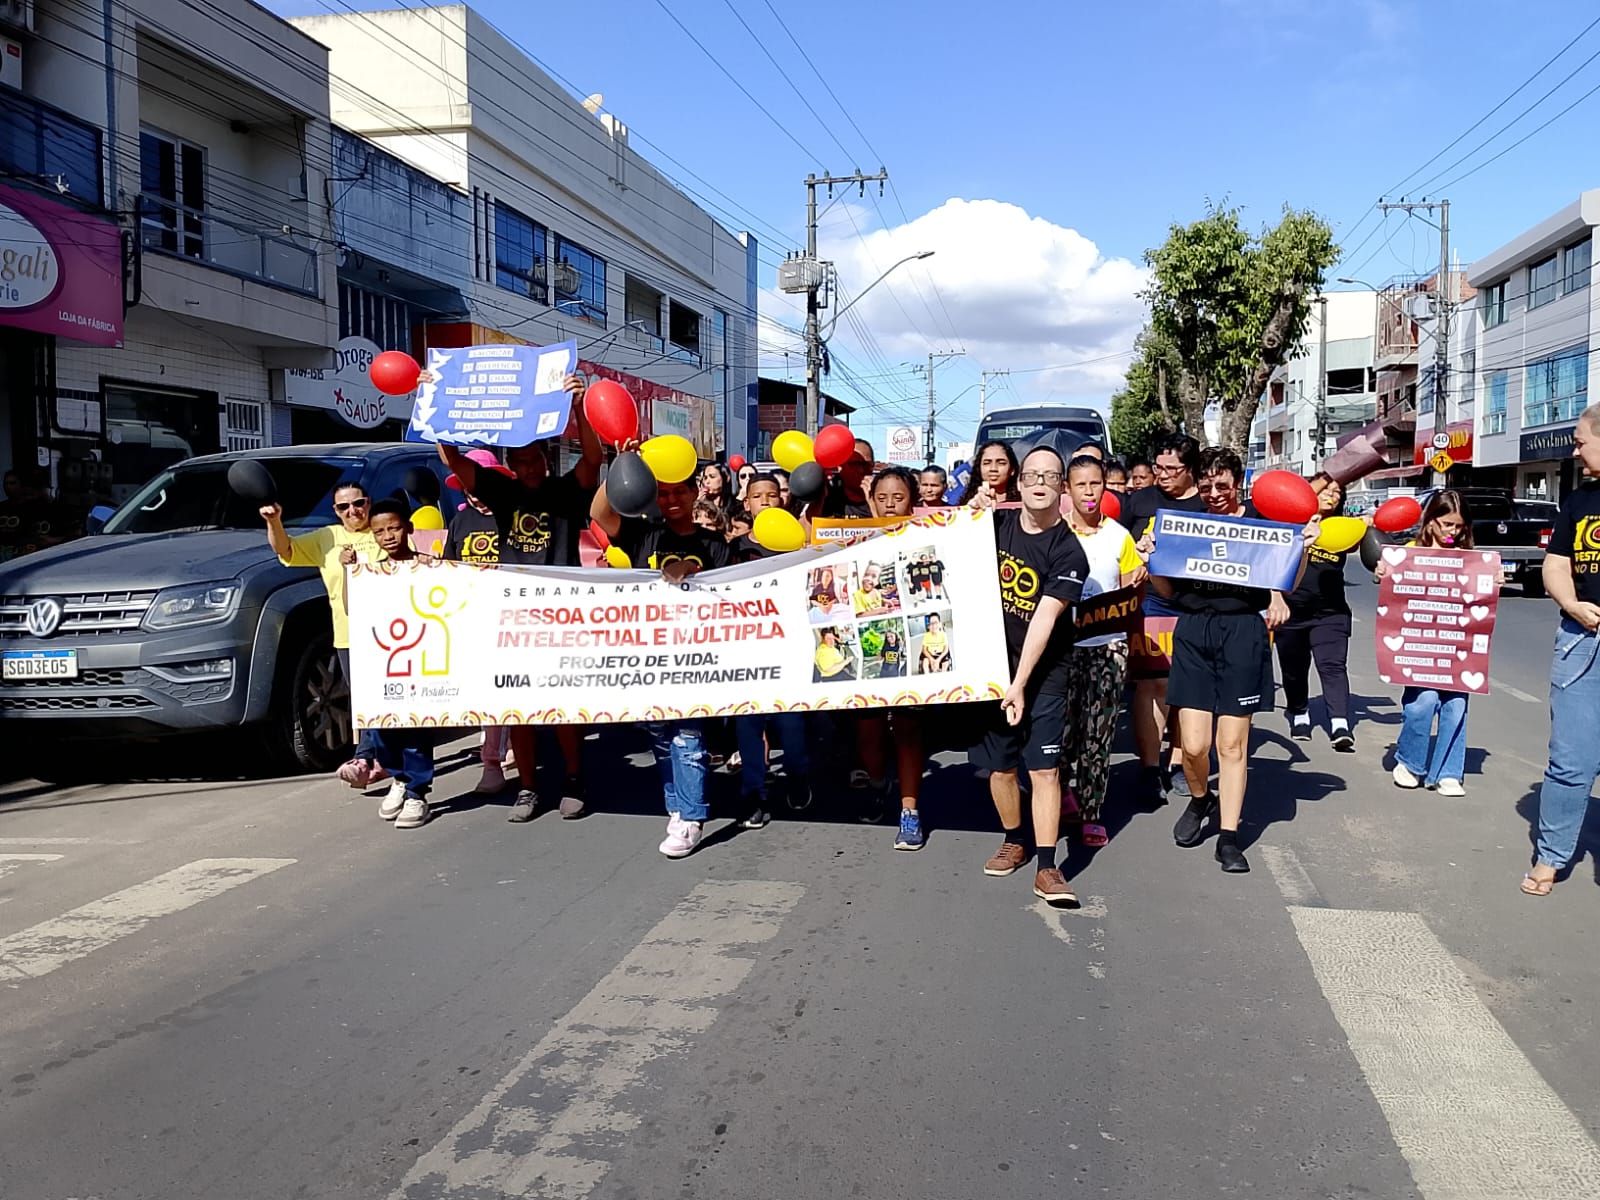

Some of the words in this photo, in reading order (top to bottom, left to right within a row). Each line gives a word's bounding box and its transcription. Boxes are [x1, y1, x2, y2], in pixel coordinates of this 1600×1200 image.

[58, 310, 77, 323] LOJA
[88, 317, 116, 333] FÁBRICA
[344, 394, 386, 423] SAÚDE
[1434, 436, 1447, 444] 40
[1162, 519, 1292, 544] BRINCADEIRAS
[1215, 545, 1226, 558] E
[1188, 560, 1249, 577] JOGOS
[503, 586, 597, 598] SEMANA
[753, 578, 779, 589] DA
[499, 606, 585, 626] PESSOA
[589, 603, 641, 625] COM
[496, 628, 649, 649] INTELECTUAL
[653, 627, 669, 646] E
[672, 620, 786, 645] MÚLTIPLA
[9, 659, 68, 675] SGD3E05
[559, 655, 641, 670] PROJETO
[644, 655, 668, 668] DE
[672, 652, 719, 667] VIDA:
[493, 674, 532, 688] UMA
[536, 669, 656, 690] CONSTRUÇÃO
[659, 665, 782, 686] PERMANENTE
